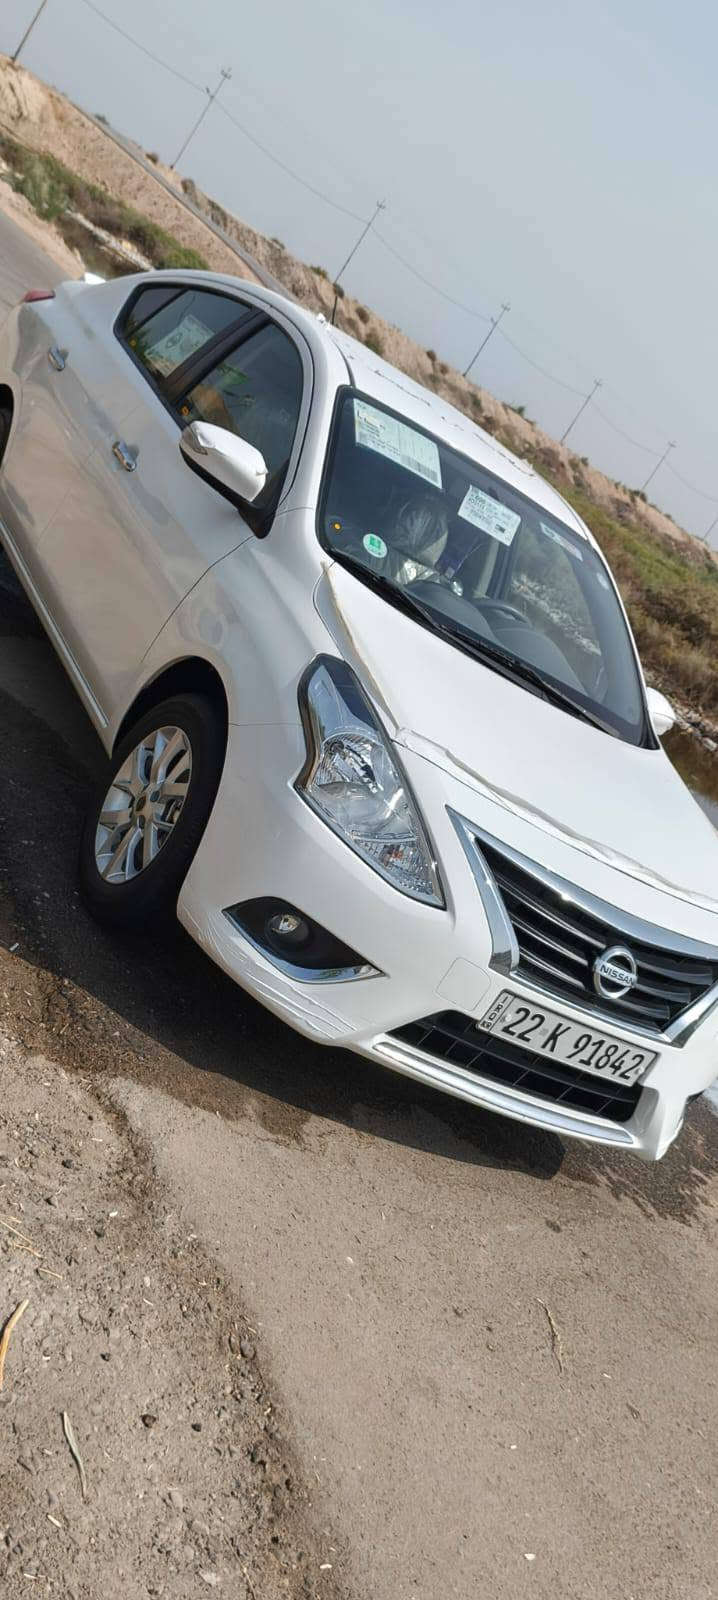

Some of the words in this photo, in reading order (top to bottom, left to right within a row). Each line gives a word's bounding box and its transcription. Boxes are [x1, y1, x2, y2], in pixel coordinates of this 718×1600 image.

[600, 964, 635, 986] NISSAN
[501, 1007, 546, 1043] 22
[540, 1022, 572, 1053] K
[566, 1033, 645, 1080] 91842
